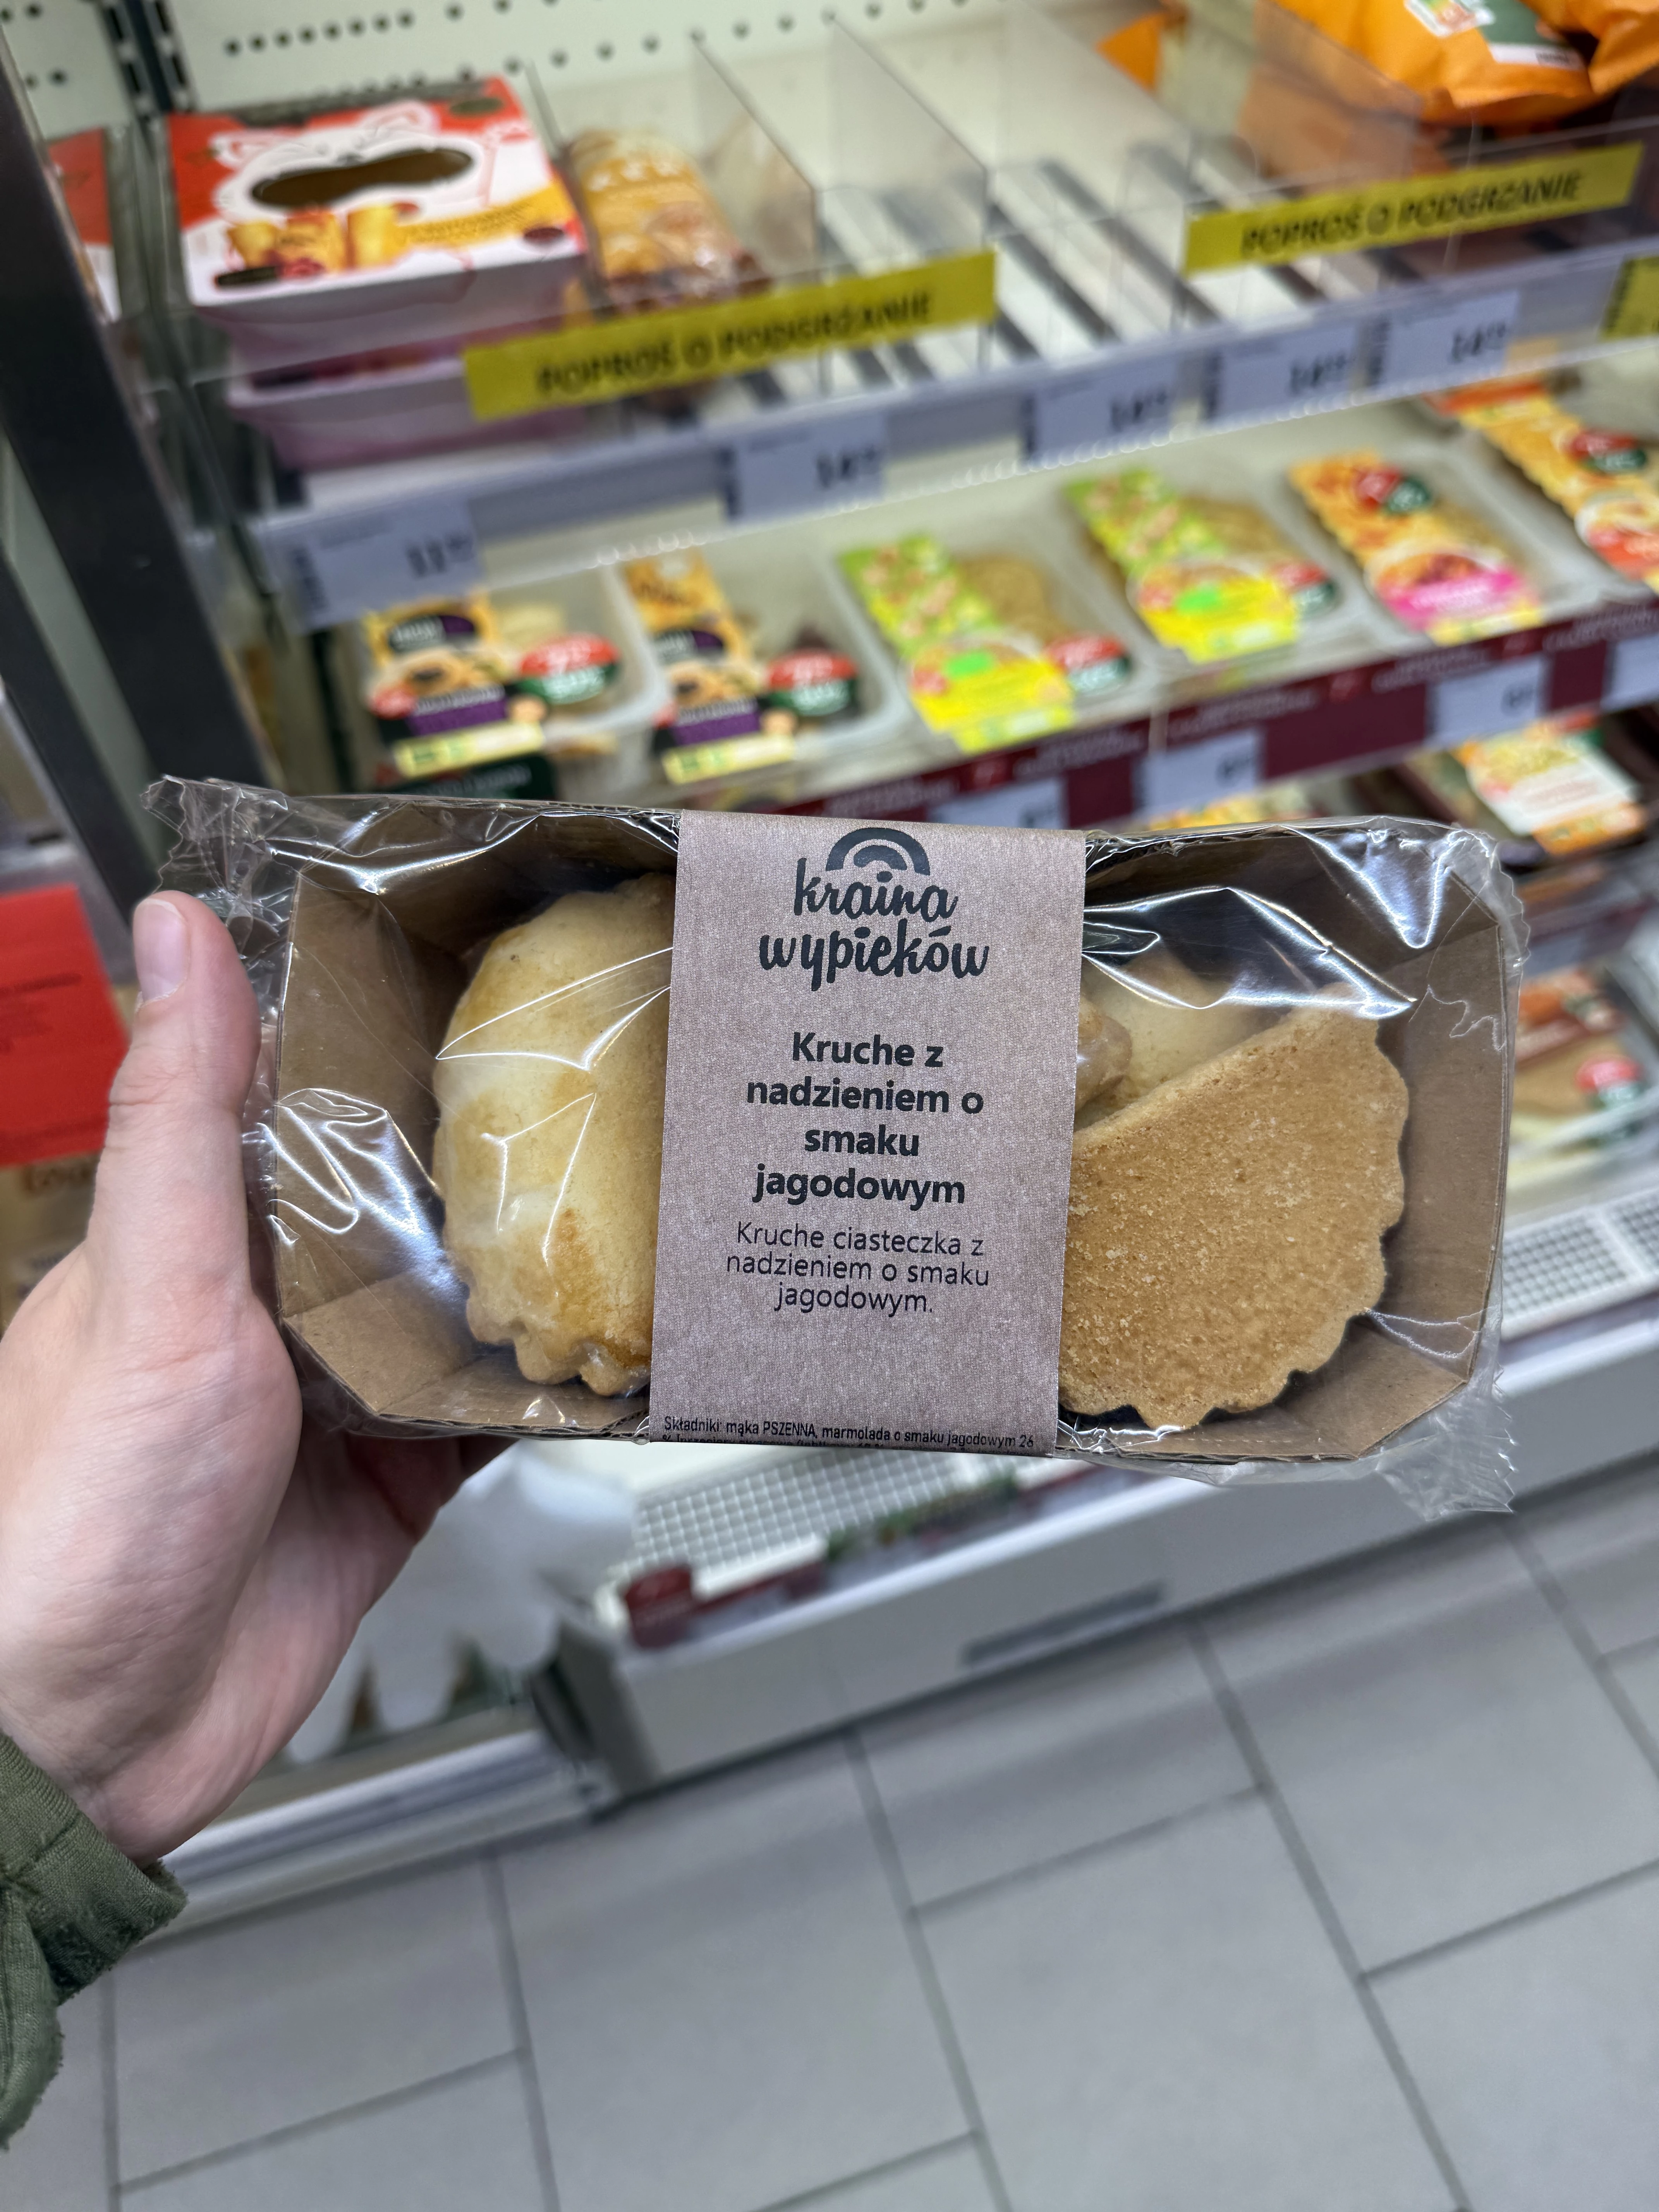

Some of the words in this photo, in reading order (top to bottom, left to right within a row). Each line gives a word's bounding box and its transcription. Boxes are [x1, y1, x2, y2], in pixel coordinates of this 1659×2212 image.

[793, 857, 959, 923] kraina
[759, 918, 989, 992] wypieków
[792, 1032, 915, 1066] Kruche
[924, 1045, 944, 1068] z
[747, 1075, 950, 1113] nadzieniem
[961, 1091, 984, 1114] o
[804, 1124, 920, 1157] smaku
[752, 1163, 965, 1211] jagodowym
[737, 1221, 824, 1248] Kruche
[833, 1226, 961, 1255] ciasteczka
[971, 1239, 984, 1256] z
[726, 1251, 871, 1280] nadzieniem
[882, 1263, 897, 1281] o
[907, 1262, 989, 1286] smaku
[774, 1282, 933, 1317] jagodowym.
[726, 1420, 760, 1437] mąka
[763, 1421, 817, 1439] PSZENNA,
[823, 1426, 890, 1441] marmolada
[894, 1431, 901, 1441] o
[904, 1431, 944, 1444] smaku
[947, 1431, 1016, 1448] jagodowym
